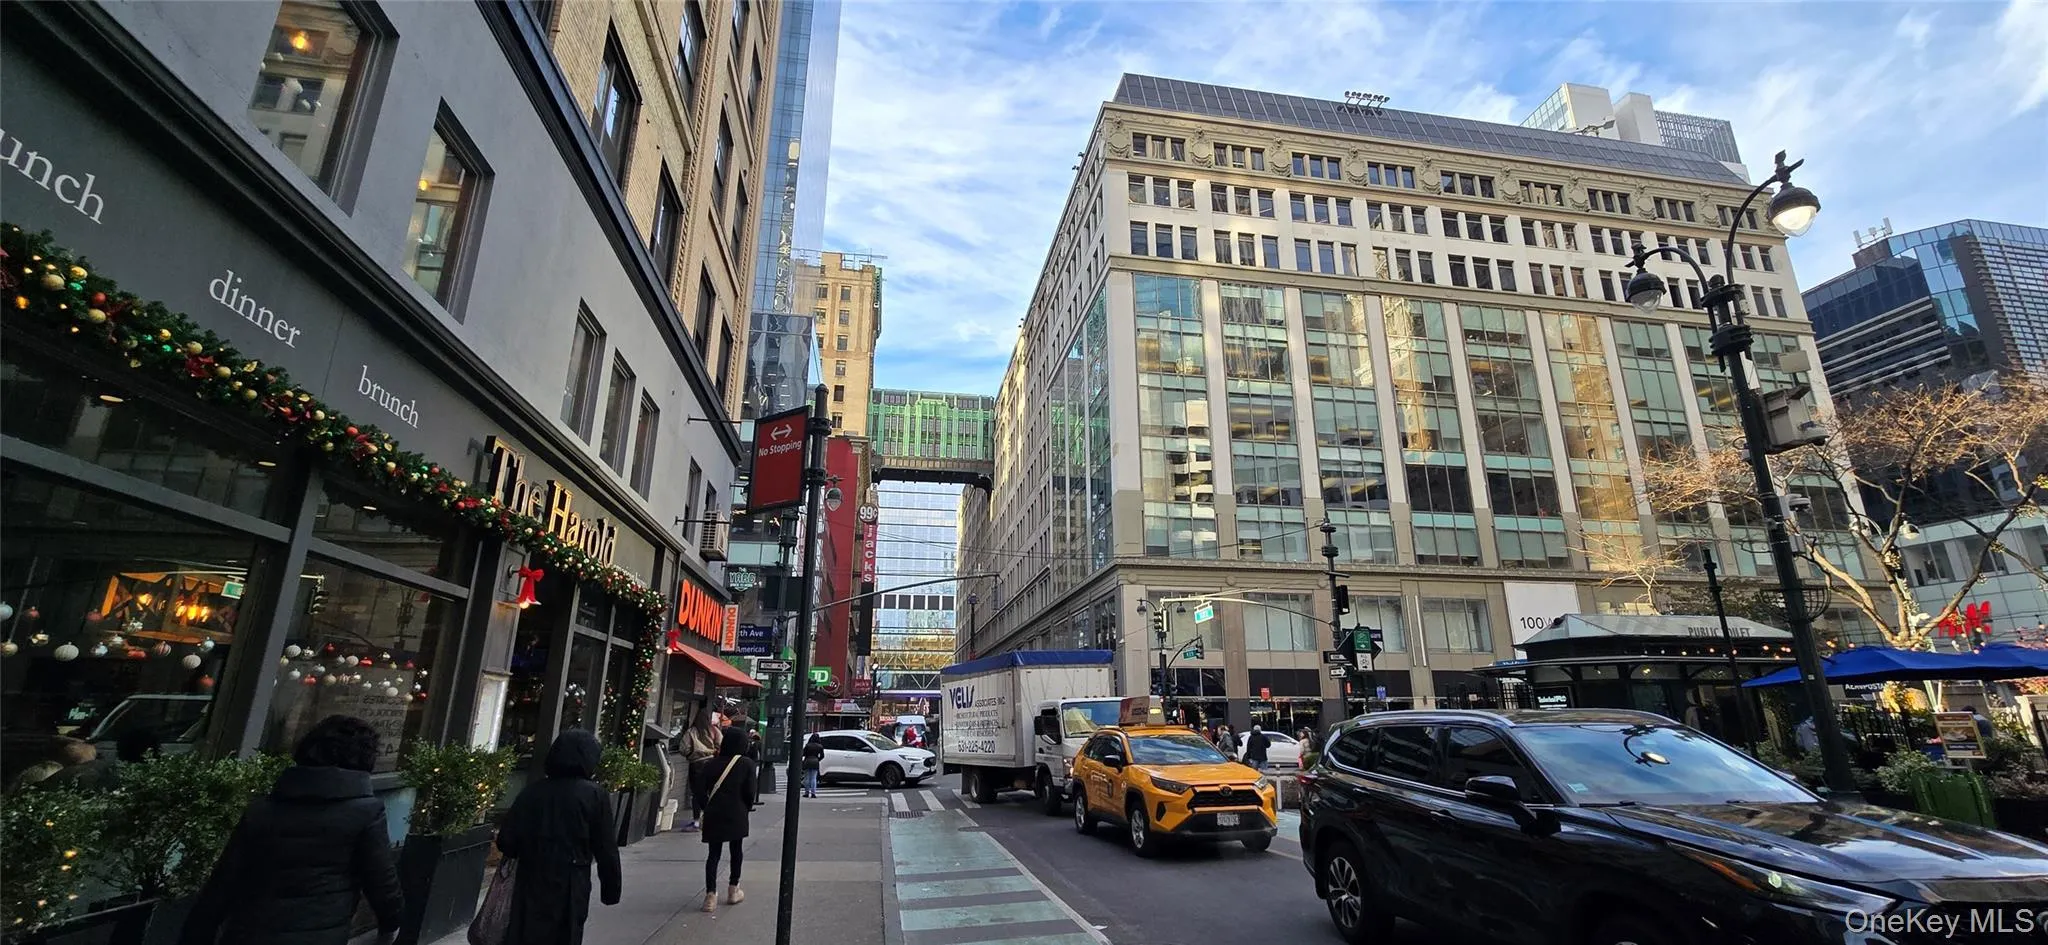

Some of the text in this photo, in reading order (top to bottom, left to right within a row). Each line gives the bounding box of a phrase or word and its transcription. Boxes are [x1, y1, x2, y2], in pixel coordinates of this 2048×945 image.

[208, 269, 301, 349] dinner
[358, 364, 420, 429] brunch
[758, 440, 802, 457] No Stopping
[486, 435, 619, 568] The Harold
[859, 505, 878, 520] 99¢
[749, 629, 764, 637] Ave
[1687, 626, 1752, 638] PUBLIC OILET
[811, 670, 829, 683] TD
